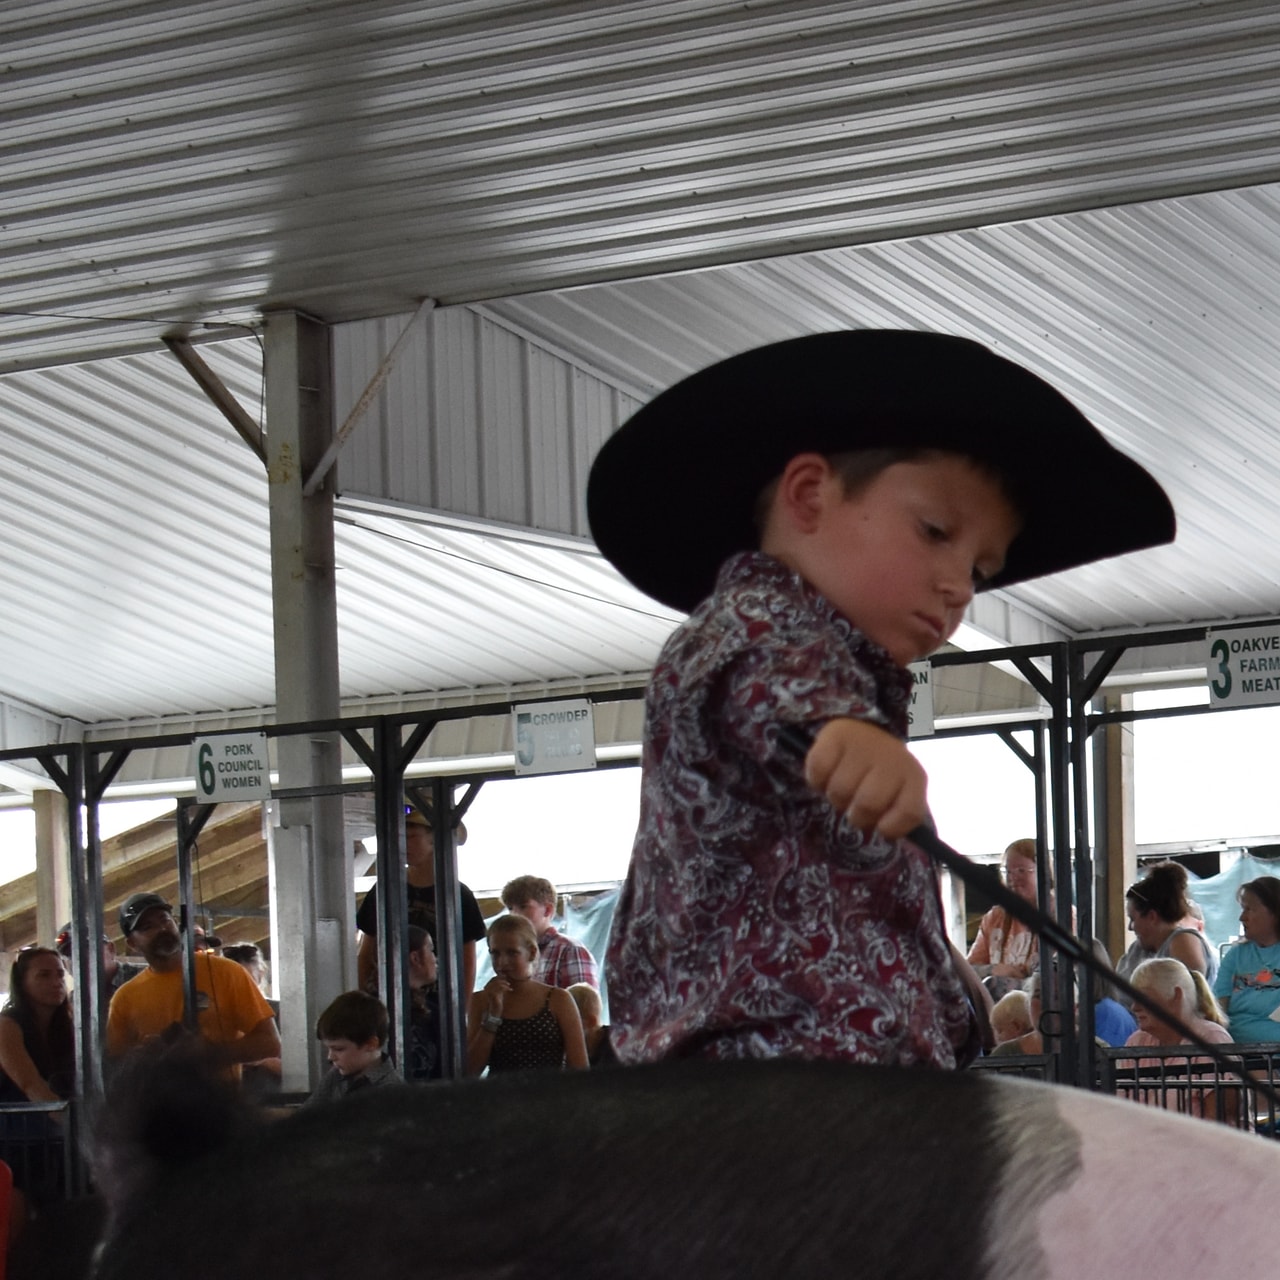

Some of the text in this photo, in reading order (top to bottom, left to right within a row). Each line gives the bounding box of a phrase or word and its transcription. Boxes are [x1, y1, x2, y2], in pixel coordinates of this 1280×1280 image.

[1210, 638, 1232, 699] 3
[533, 709, 588, 726] CROWDER
[517, 712, 534, 767] 5
[224, 744, 254, 757] PORK
[199, 742, 216, 796] 6
[217, 760, 264, 773] COUNCIL
[221, 776, 261, 789] WOMEN
